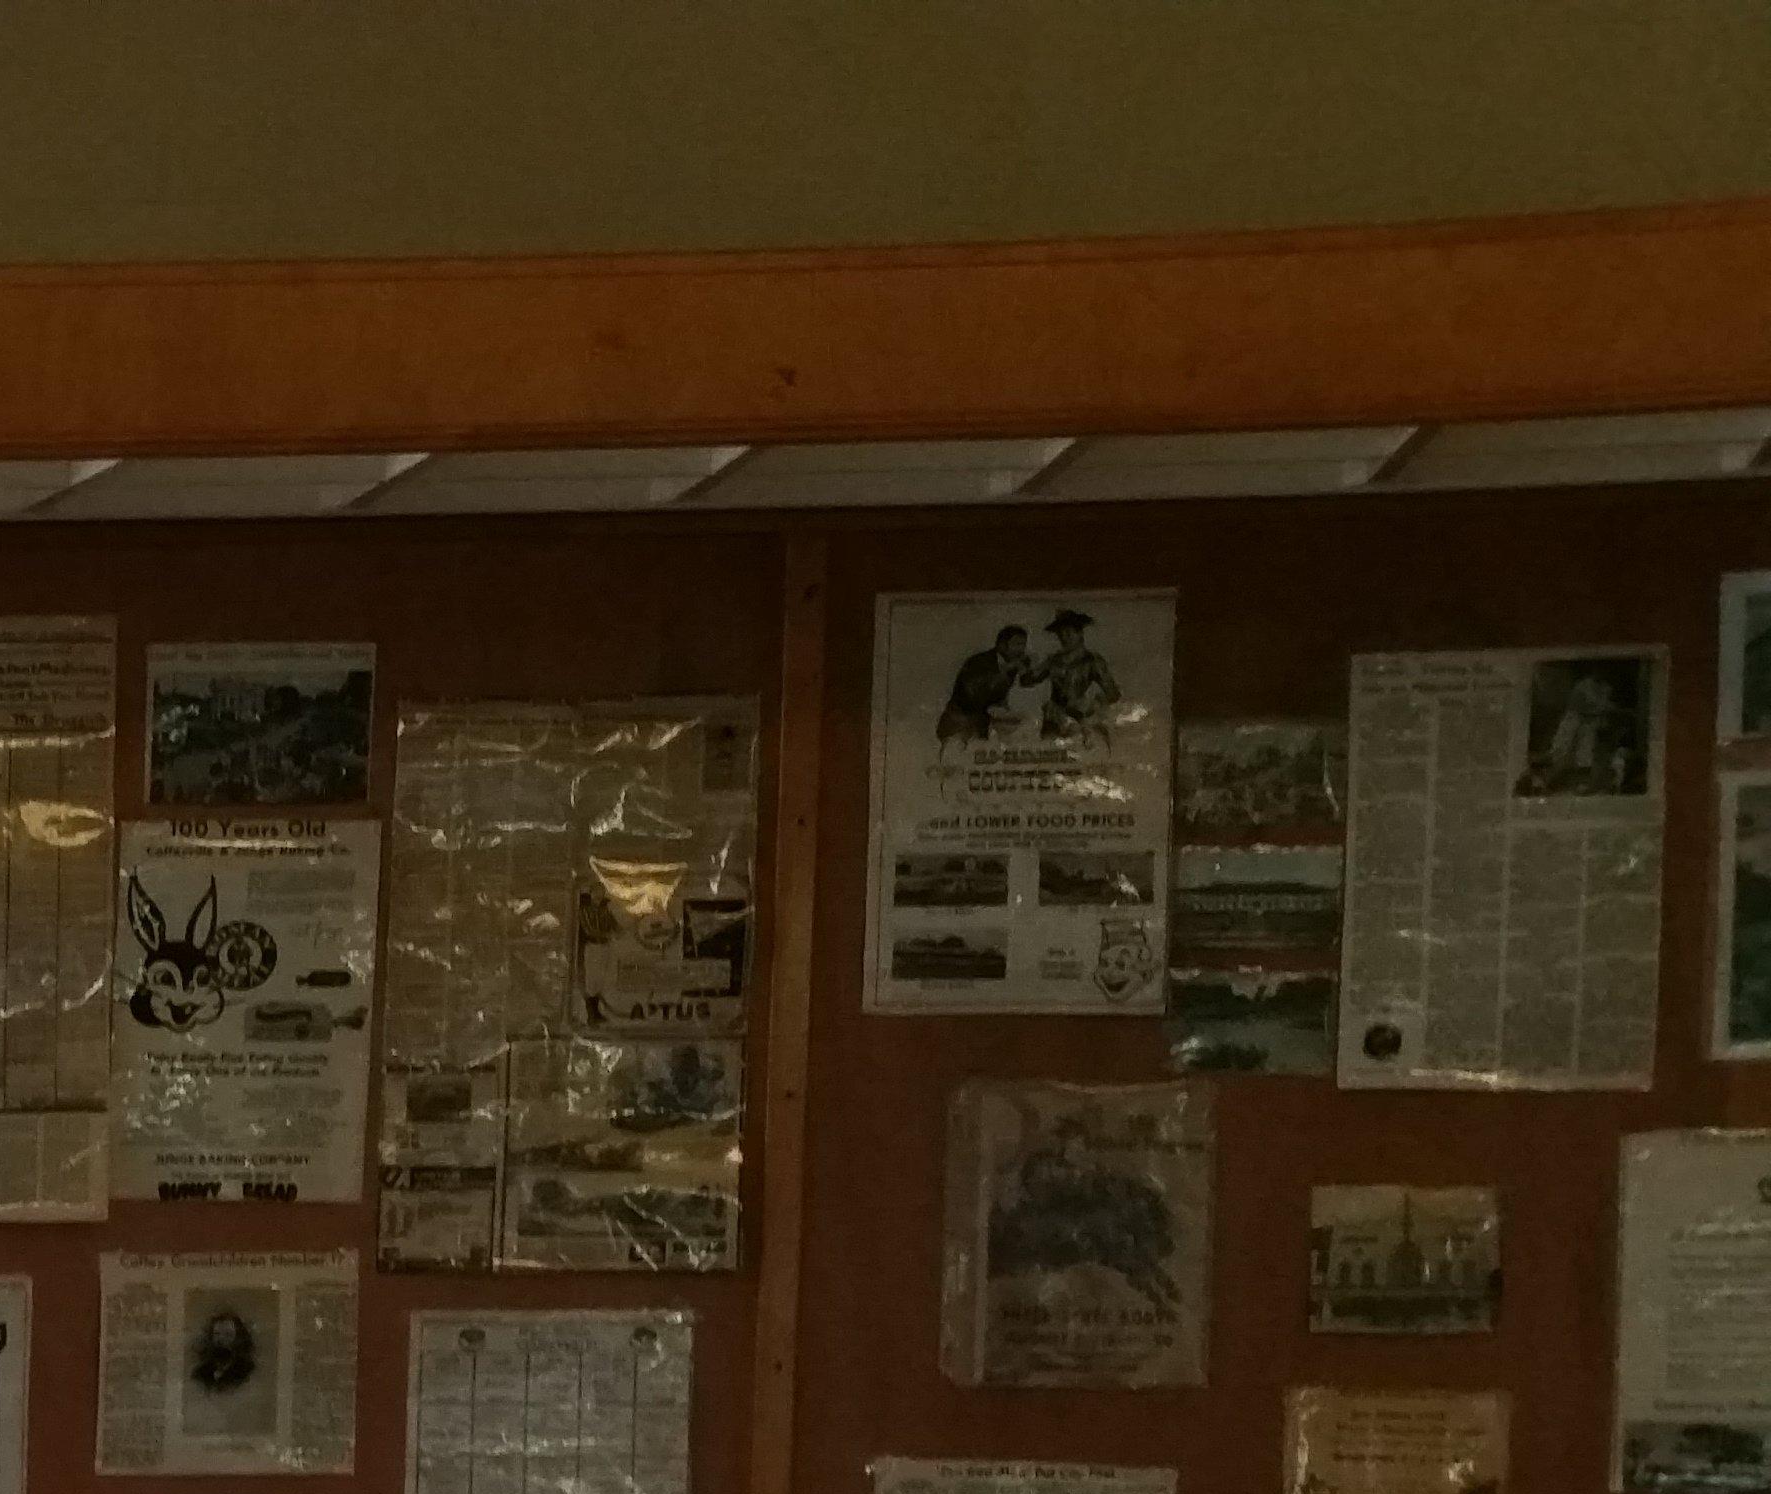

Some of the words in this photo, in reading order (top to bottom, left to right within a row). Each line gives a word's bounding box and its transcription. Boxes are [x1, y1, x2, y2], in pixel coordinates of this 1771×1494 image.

[169, 819, 209, 839] 100
[218, 819, 280, 839] Years
[287, 818, 327, 838] Old
[1027, 812, 1076, 829] FOOD
[1081, 811, 1136, 828] PRICES
